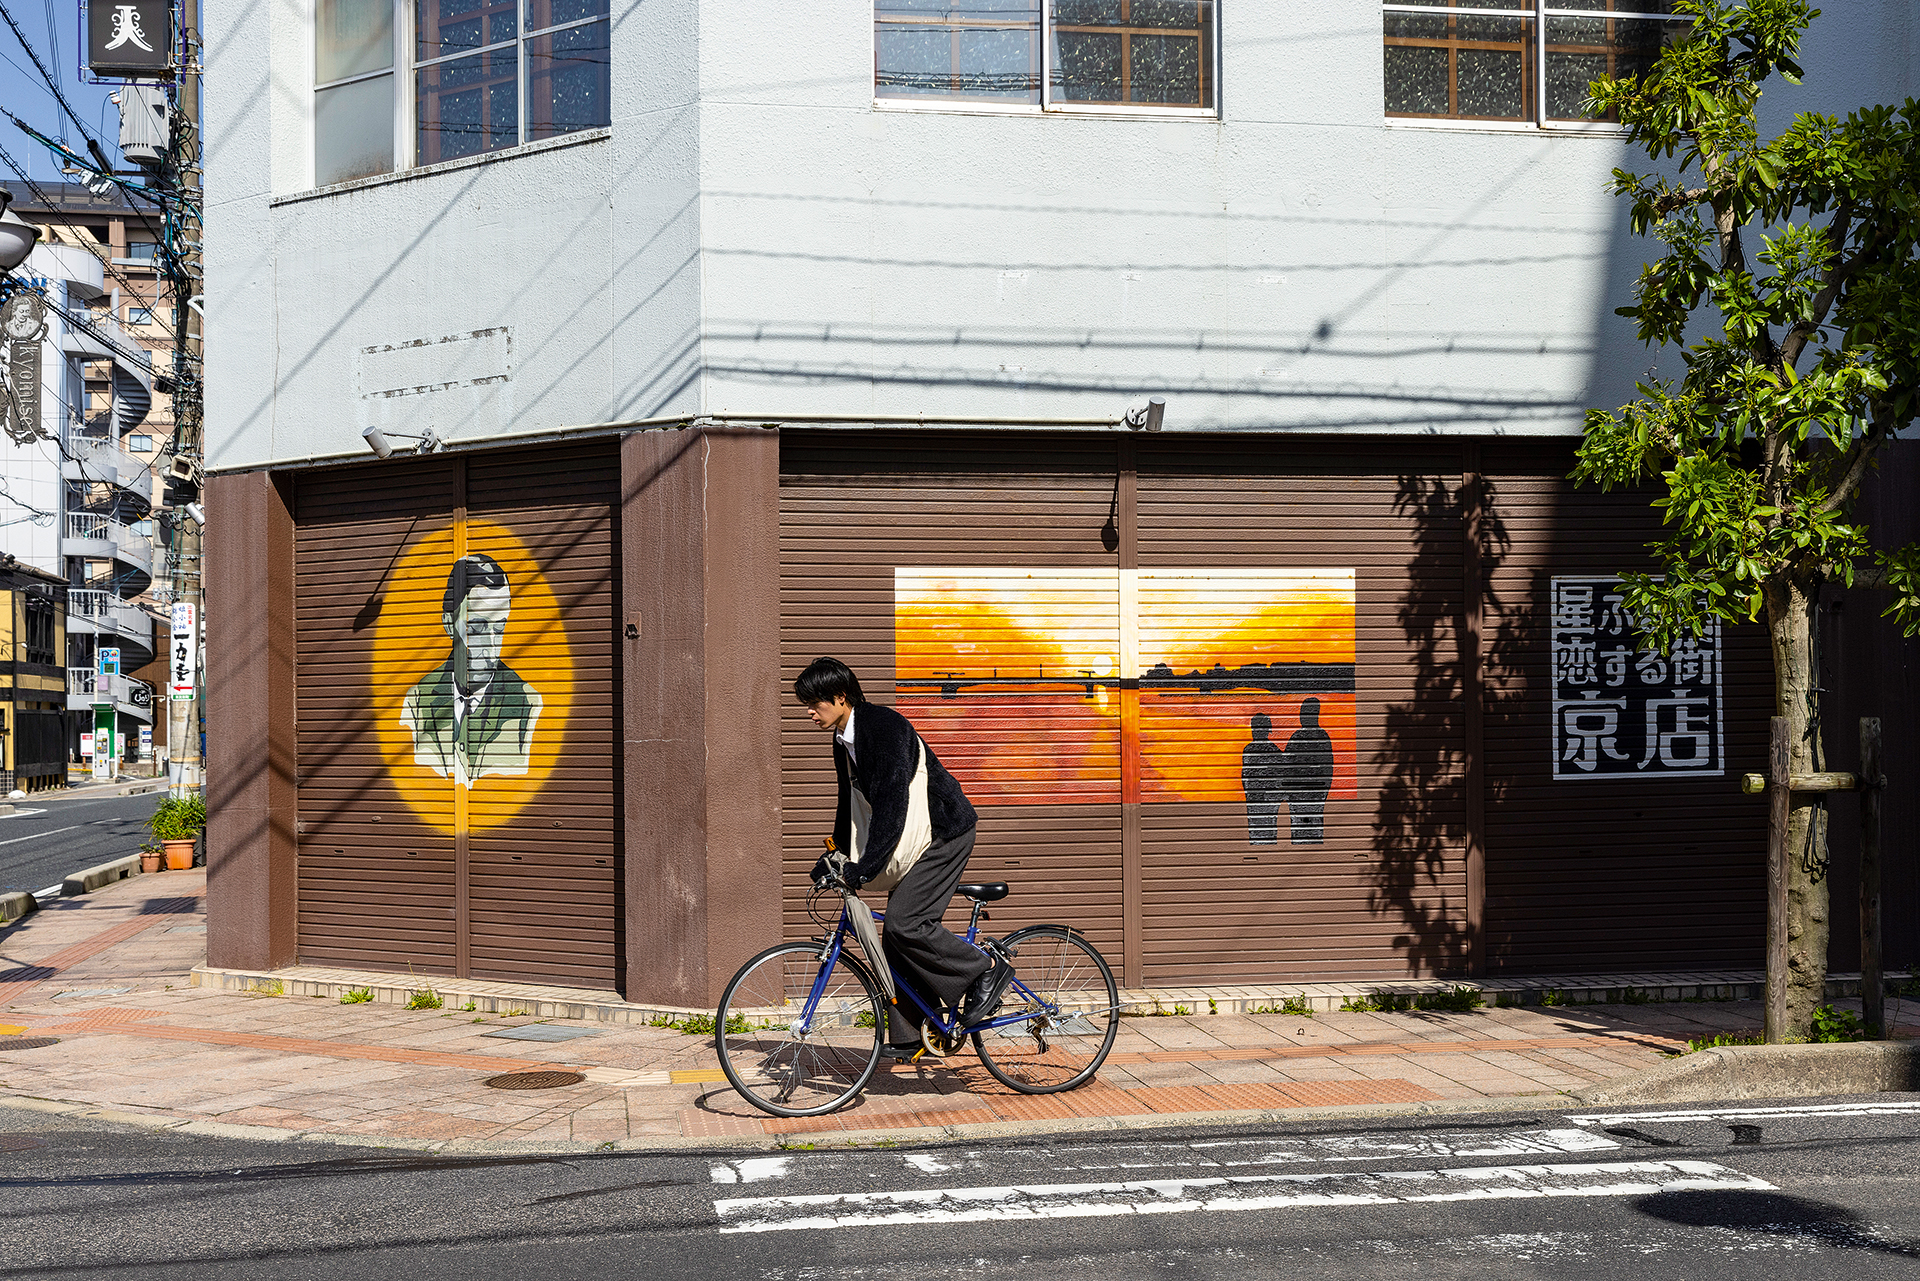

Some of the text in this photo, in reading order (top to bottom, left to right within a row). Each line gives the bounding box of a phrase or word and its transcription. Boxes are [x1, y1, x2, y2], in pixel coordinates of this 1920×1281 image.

[1557, 586, 1714, 636] 星ふ
[1556, 637, 1715, 687] 恋する街
[1557, 689, 1710, 771] 京店
